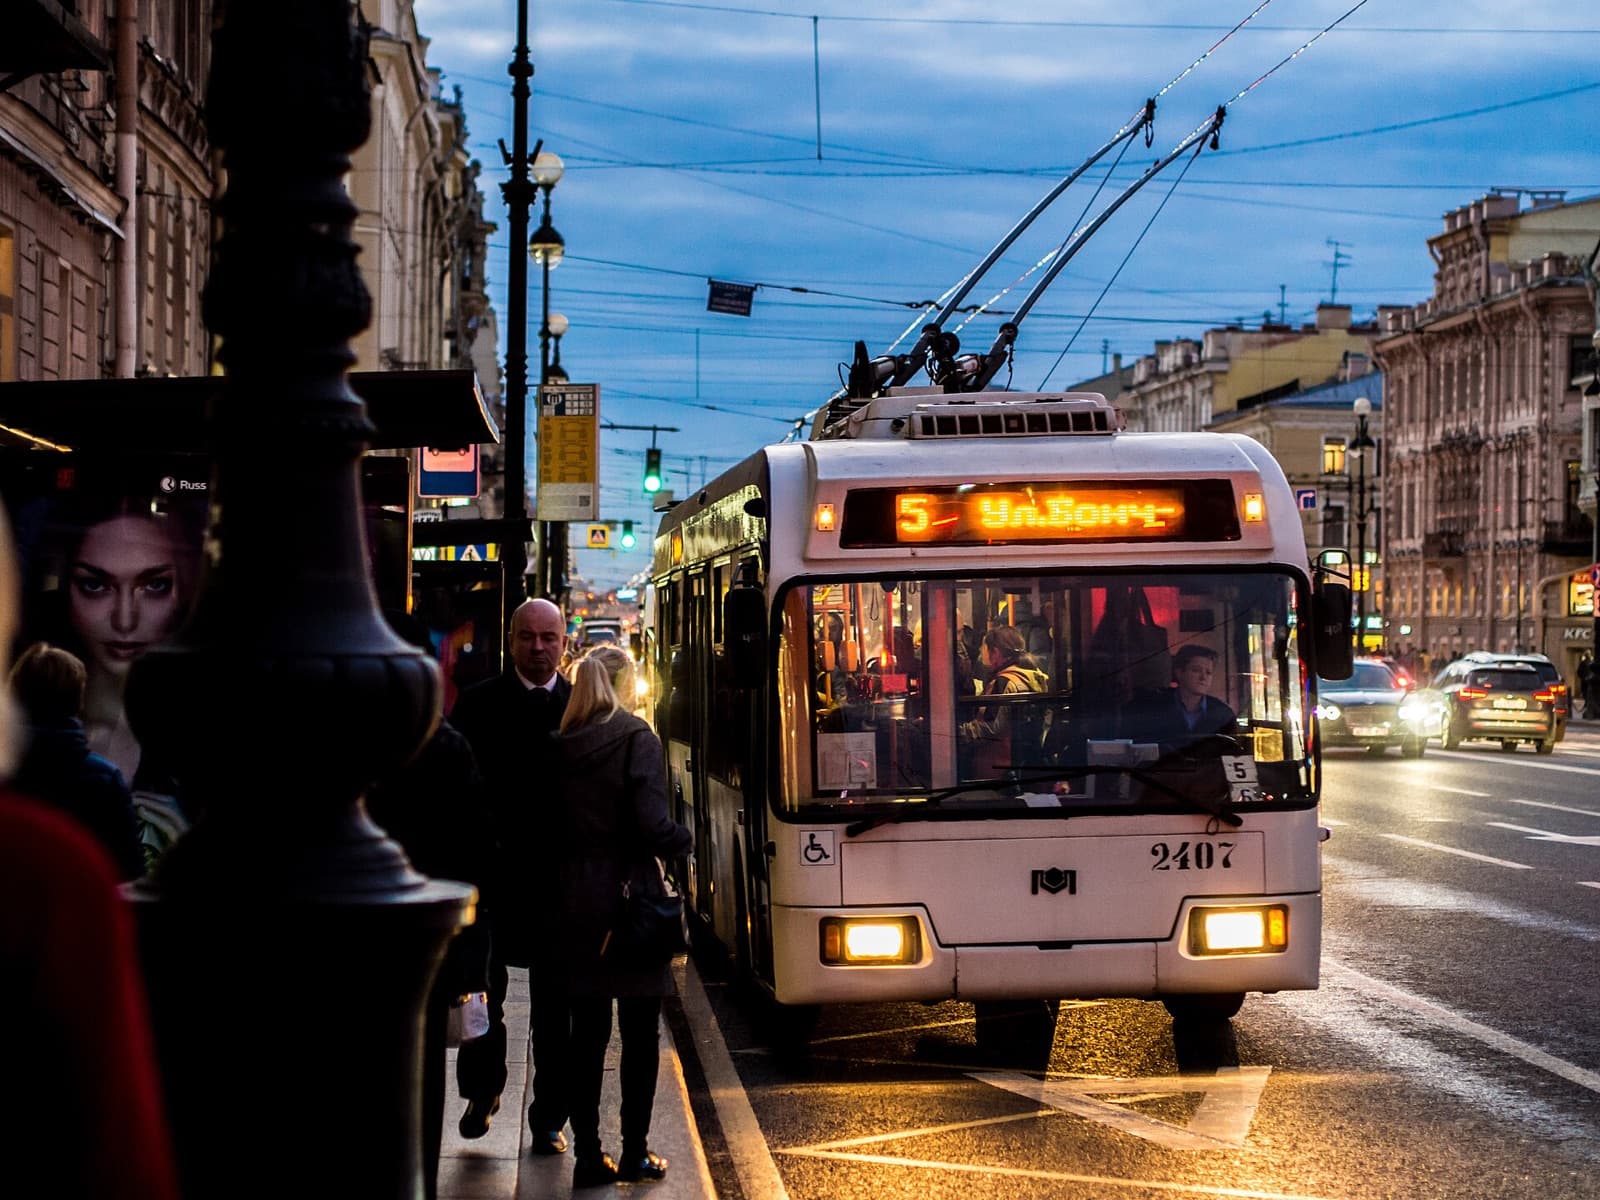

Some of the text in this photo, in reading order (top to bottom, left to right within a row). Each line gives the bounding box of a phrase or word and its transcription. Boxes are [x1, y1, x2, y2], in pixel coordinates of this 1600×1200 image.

[180, 480, 207, 490] Russ
[901, 498, 928, 532] 5
[1563, 627, 1592, 639] KFC
[1233, 762, 1246, 779] 5
[1151, 842, 1237, 871] 2407
